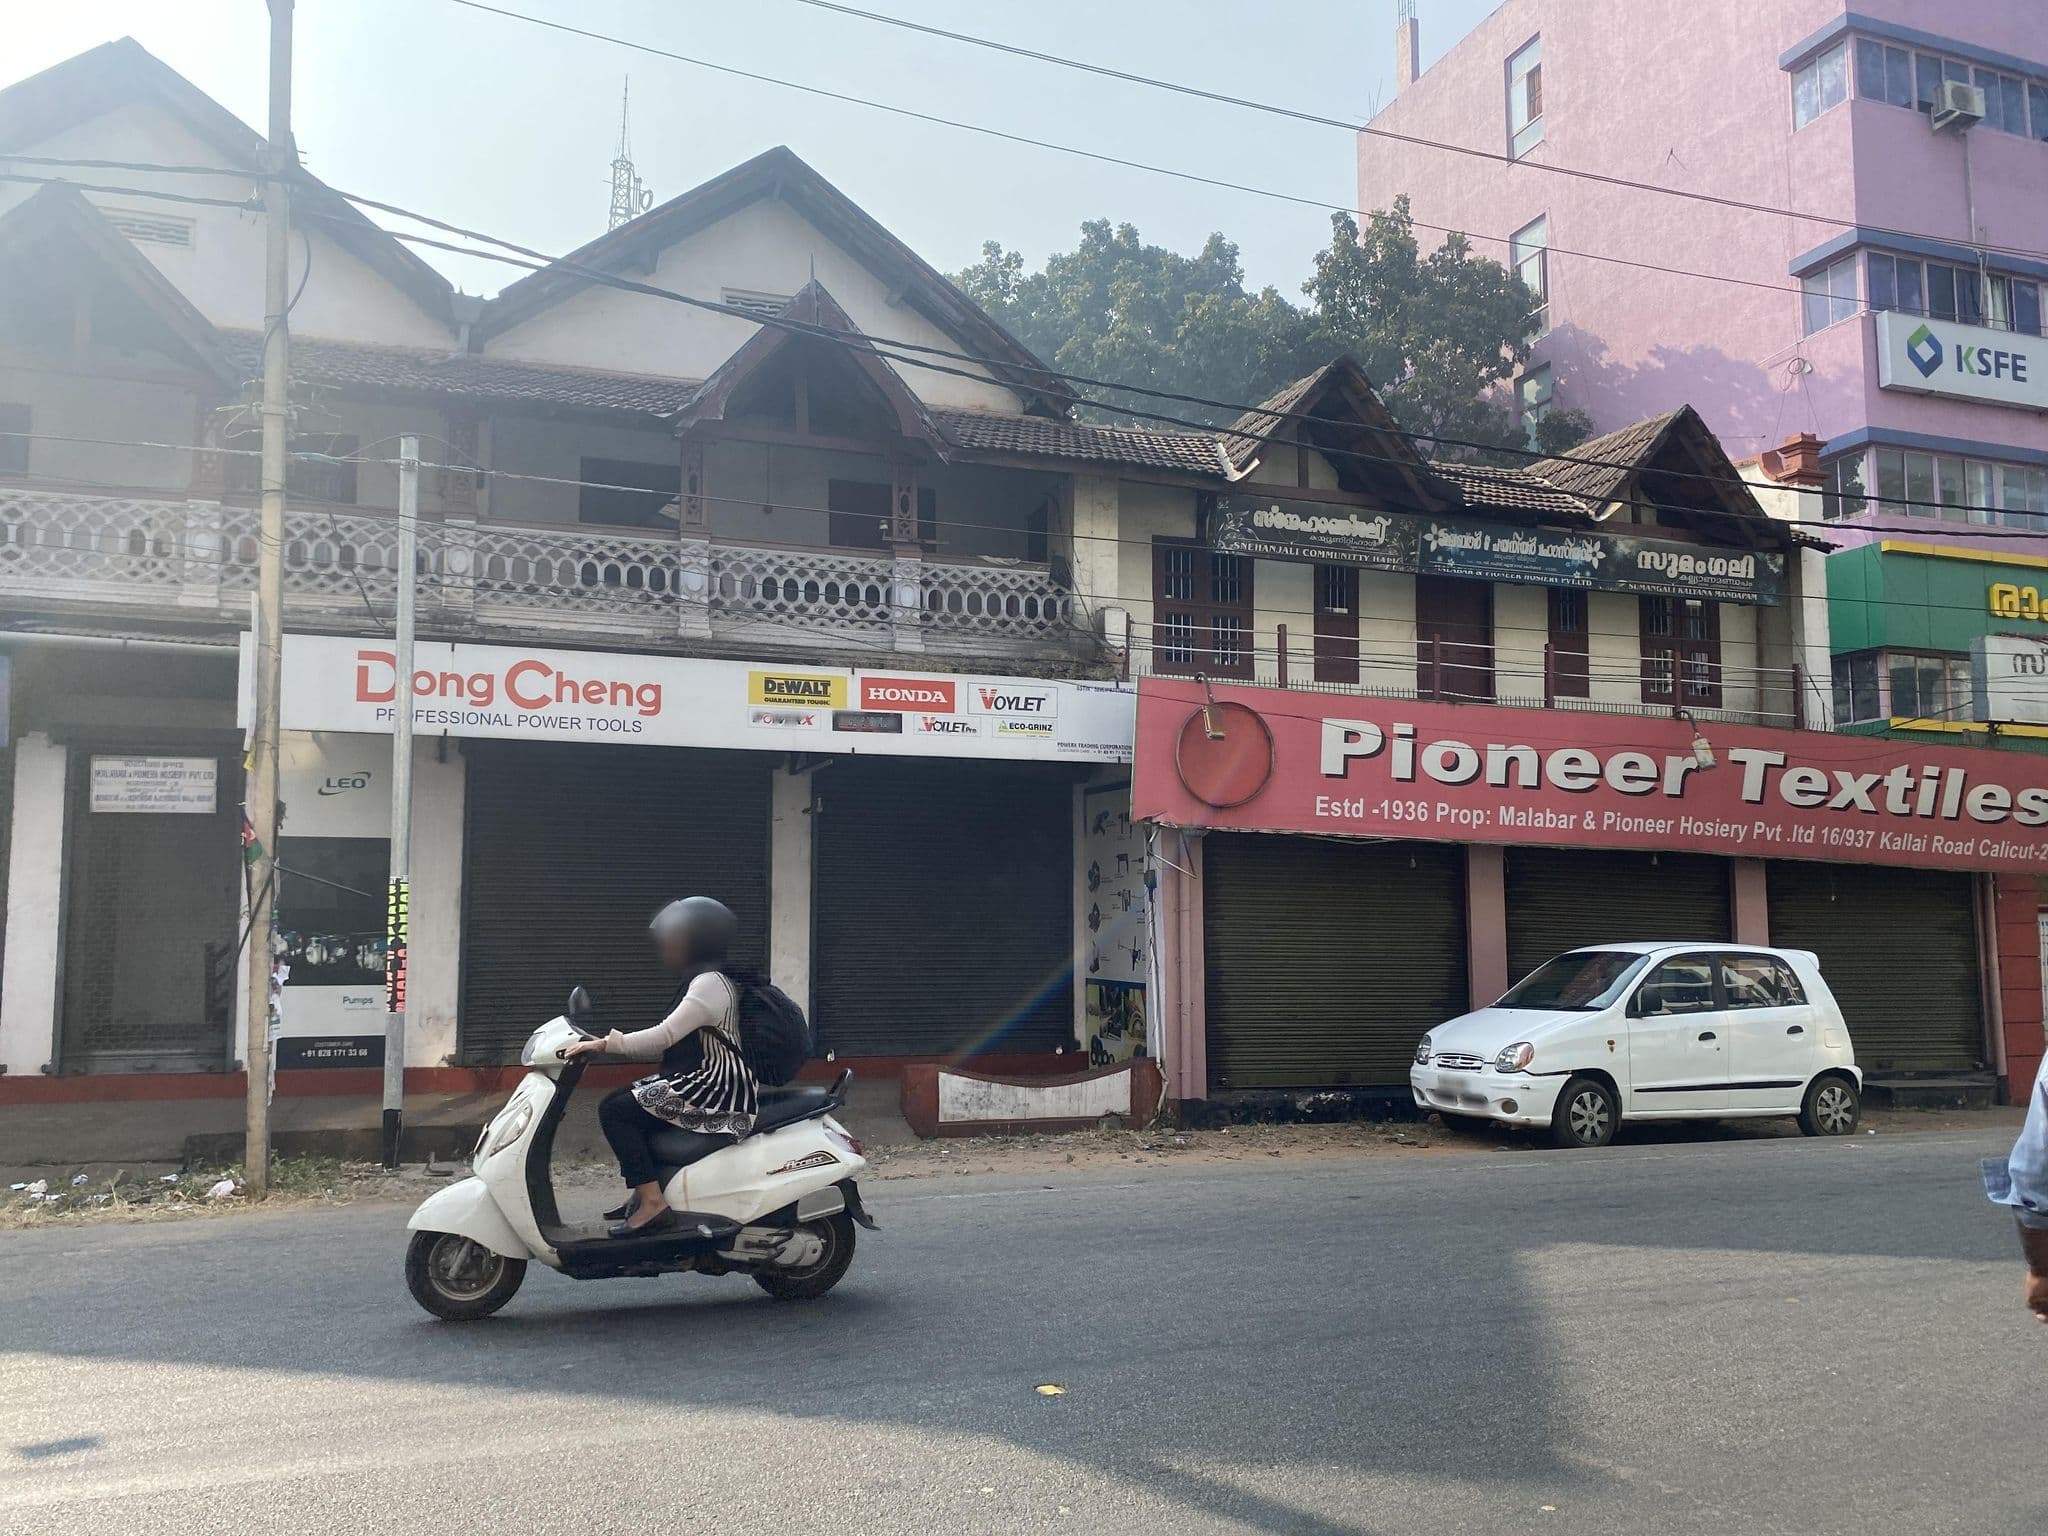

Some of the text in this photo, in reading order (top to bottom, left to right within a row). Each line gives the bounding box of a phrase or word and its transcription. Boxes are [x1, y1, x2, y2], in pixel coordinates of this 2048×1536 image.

[1955, 343, 2027, 383] KSFE
[1233, 541, 1299, 556] SNEHANJALI
[1637, 550, 1756, 579] സുമംഗലി
[355, 650, 662, 716] Dong Cheng
[867, 687, 948, 704] HONDA
[978, 688, 1046, 712] VOYLET
[376, 707, 643, 734] PRFESSIONAL POWER TOOLS
[1009, 722, 1053, 732] ECO-GRINZ
[325, 776, 367, 790] LEO
[1319, 717, 2048, 826] Pioneer Textiles
[1315, 794, 1365, 819] Estd
[1371, 798, 1428, 823] -1936
[1433, 800, 1493, 830] Prop:
[1498, 804, 1577, 832] Malabar
[1582, 810, 1597, 832] &
[1602, 810, 1675, 836] Pioneer
[1679, 814, 1748, 845] Hosiery
[1753, 818, 1781, 843] Pvt
[1820, 825, 1874, 850] 16/937
[1879, 828, 1927, 854] Kallai
[1931, 833, 1974, 857] Road
[342, 996, 373, 1005] Pumps
